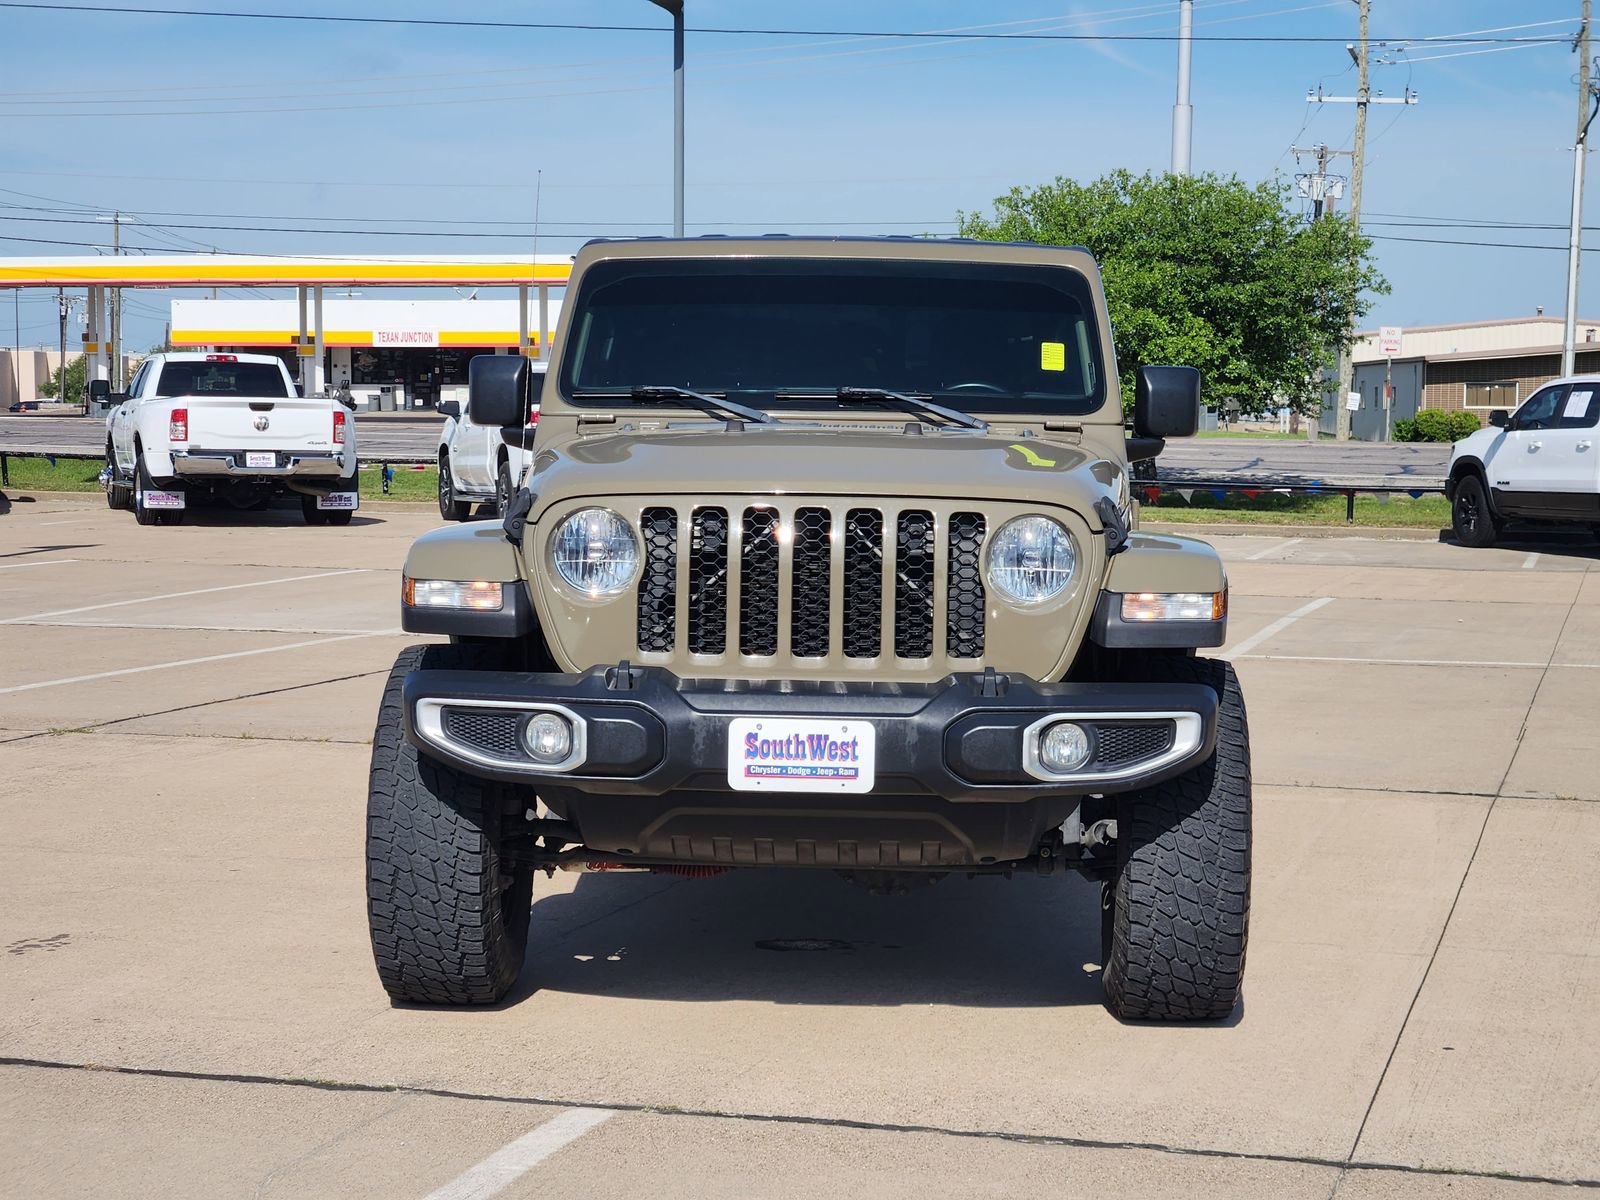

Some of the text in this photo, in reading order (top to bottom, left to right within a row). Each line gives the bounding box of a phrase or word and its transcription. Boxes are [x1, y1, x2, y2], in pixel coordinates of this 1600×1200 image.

[378, 331, 433, 343] TEXAN JUNCTION
[744, 732, 859, 761] SouthWest
[750, 765, 855, 776] Chrysler Dodge Jeep Ram
